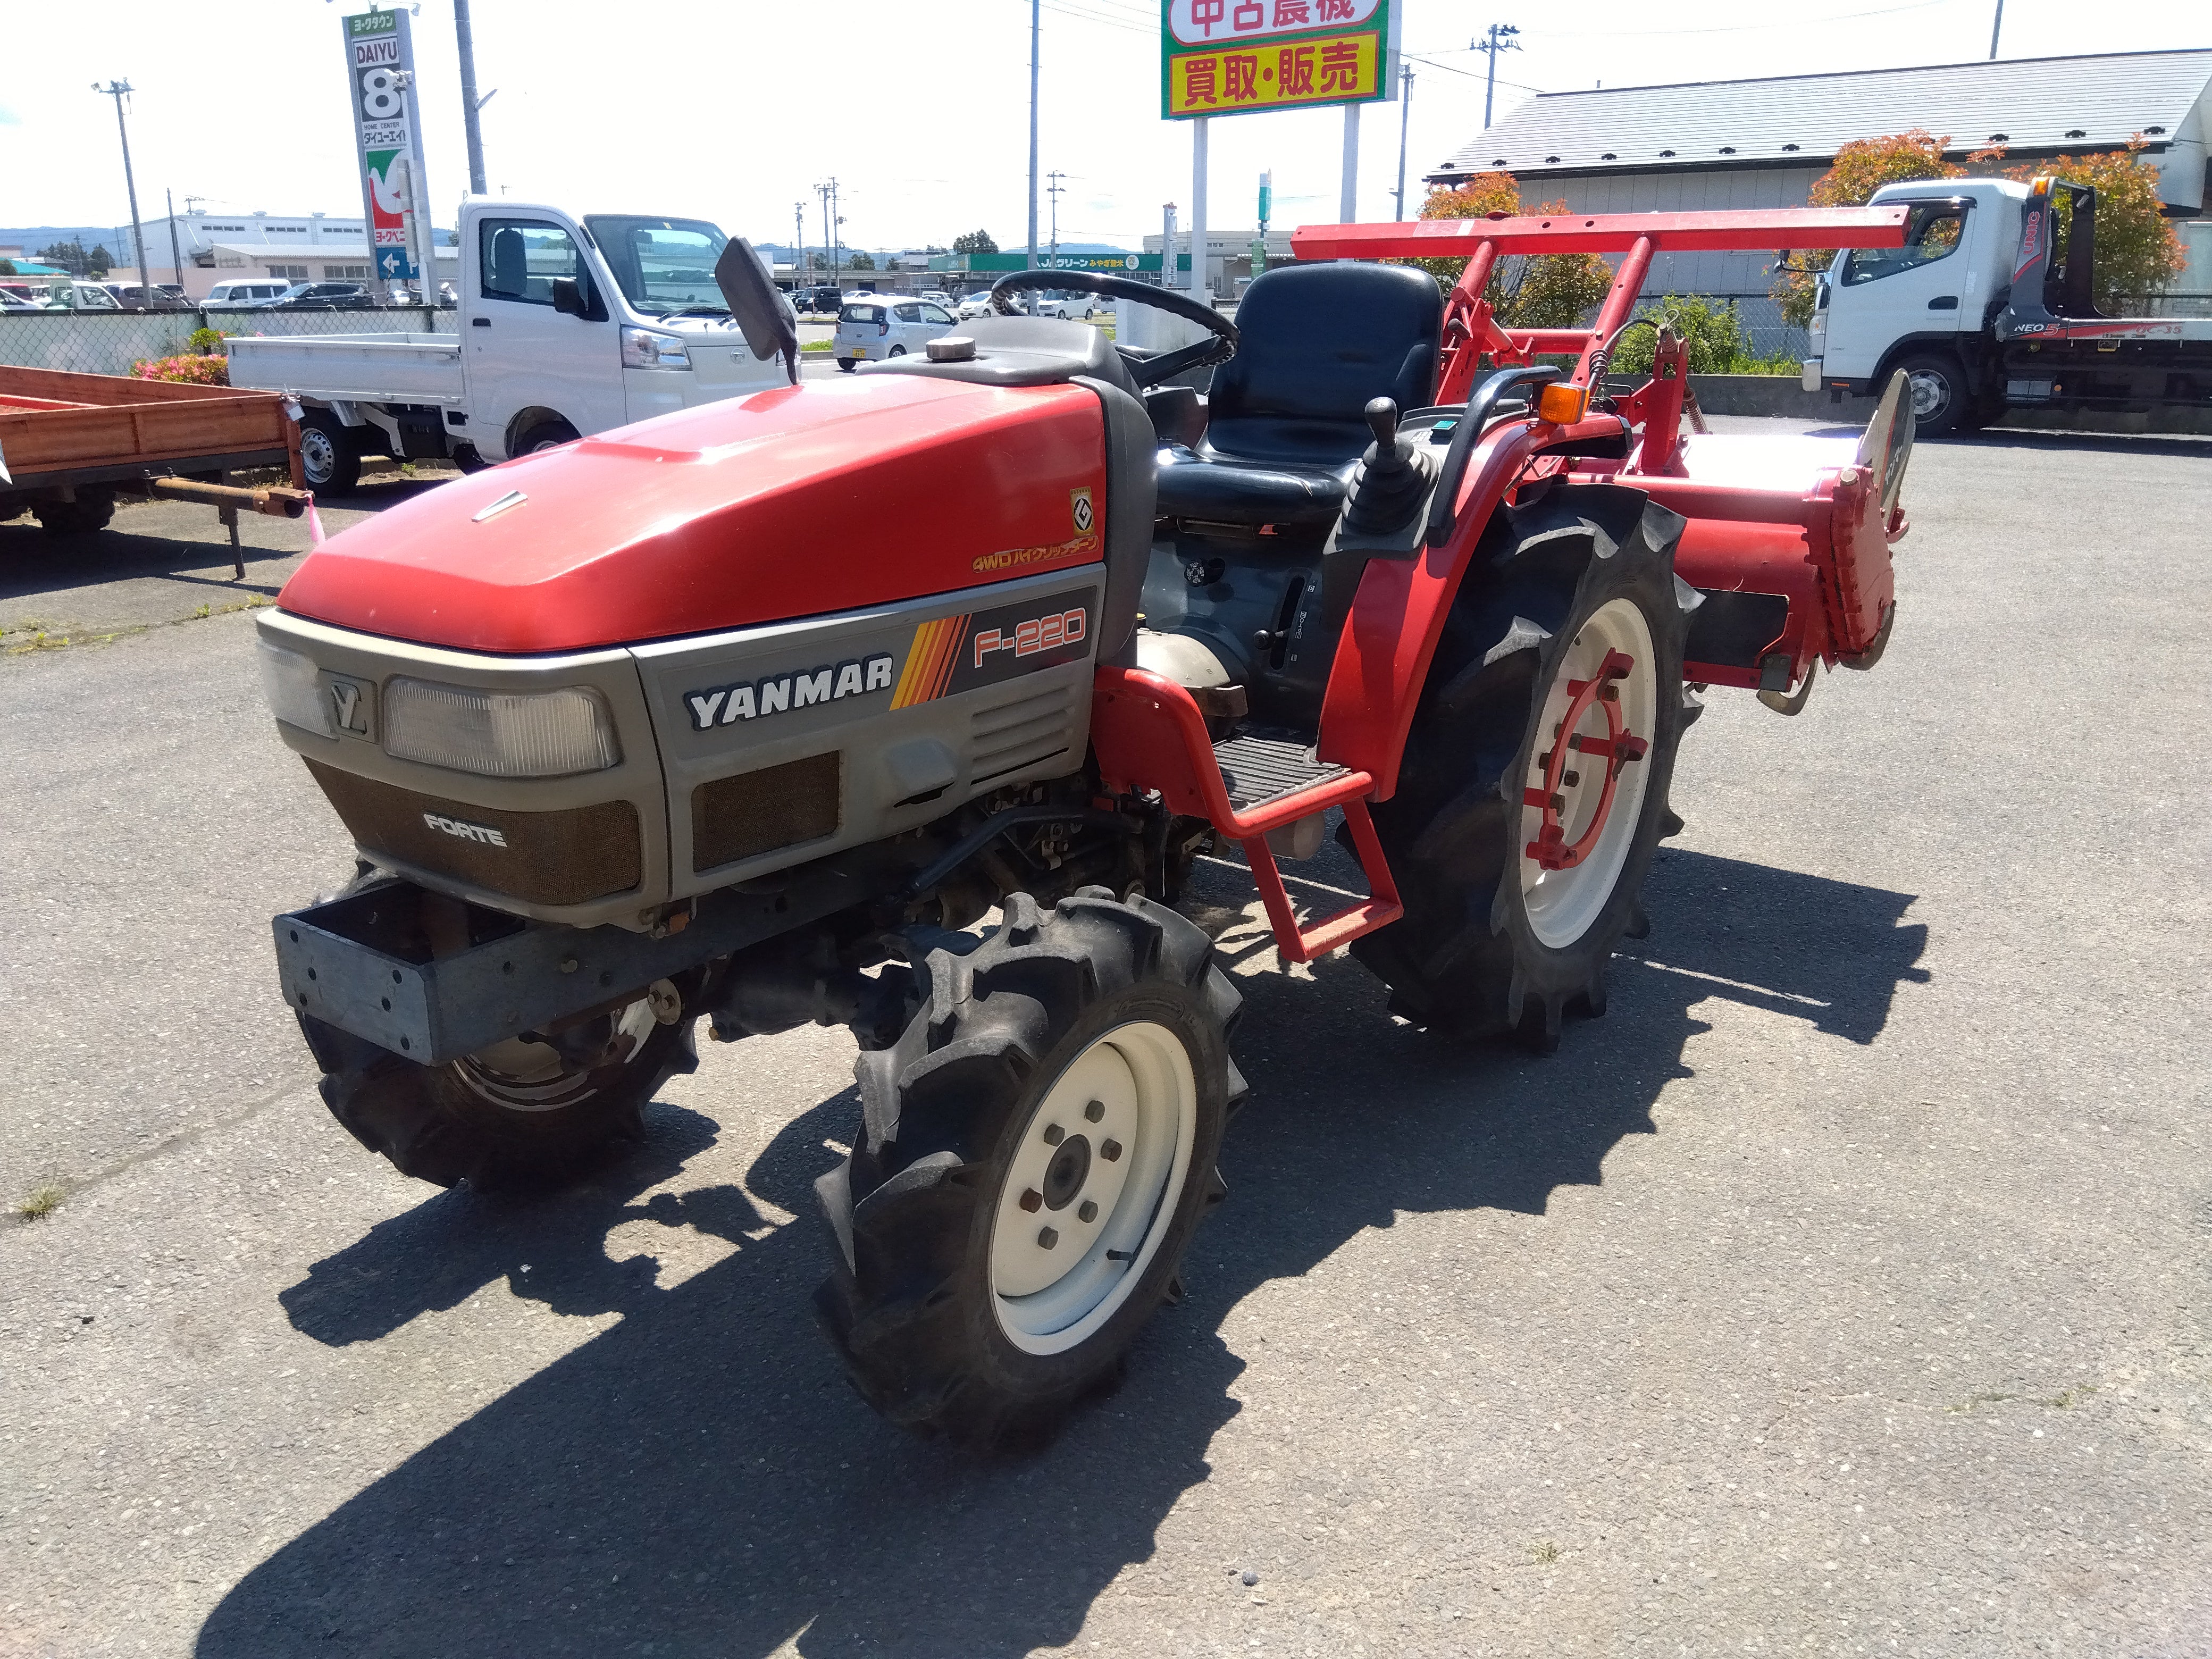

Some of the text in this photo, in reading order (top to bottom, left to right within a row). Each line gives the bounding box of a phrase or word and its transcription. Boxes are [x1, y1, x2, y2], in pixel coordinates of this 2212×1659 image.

[354, 15, 393, 31] ヨークタウン
[356, 41, 397, 64] DAIYU
[1184, 41, 1360, 107] 買取・販売
[363, 68, 401, 118] 8
[2023, 211, 2040, 255] UNIC
[2135, 325, 2183, 334] UC-35
[975, 607, 1086, 668] F-220
[688, 655, 894, 730] YANMAR
[424, 814, 508, 848] FORTE
